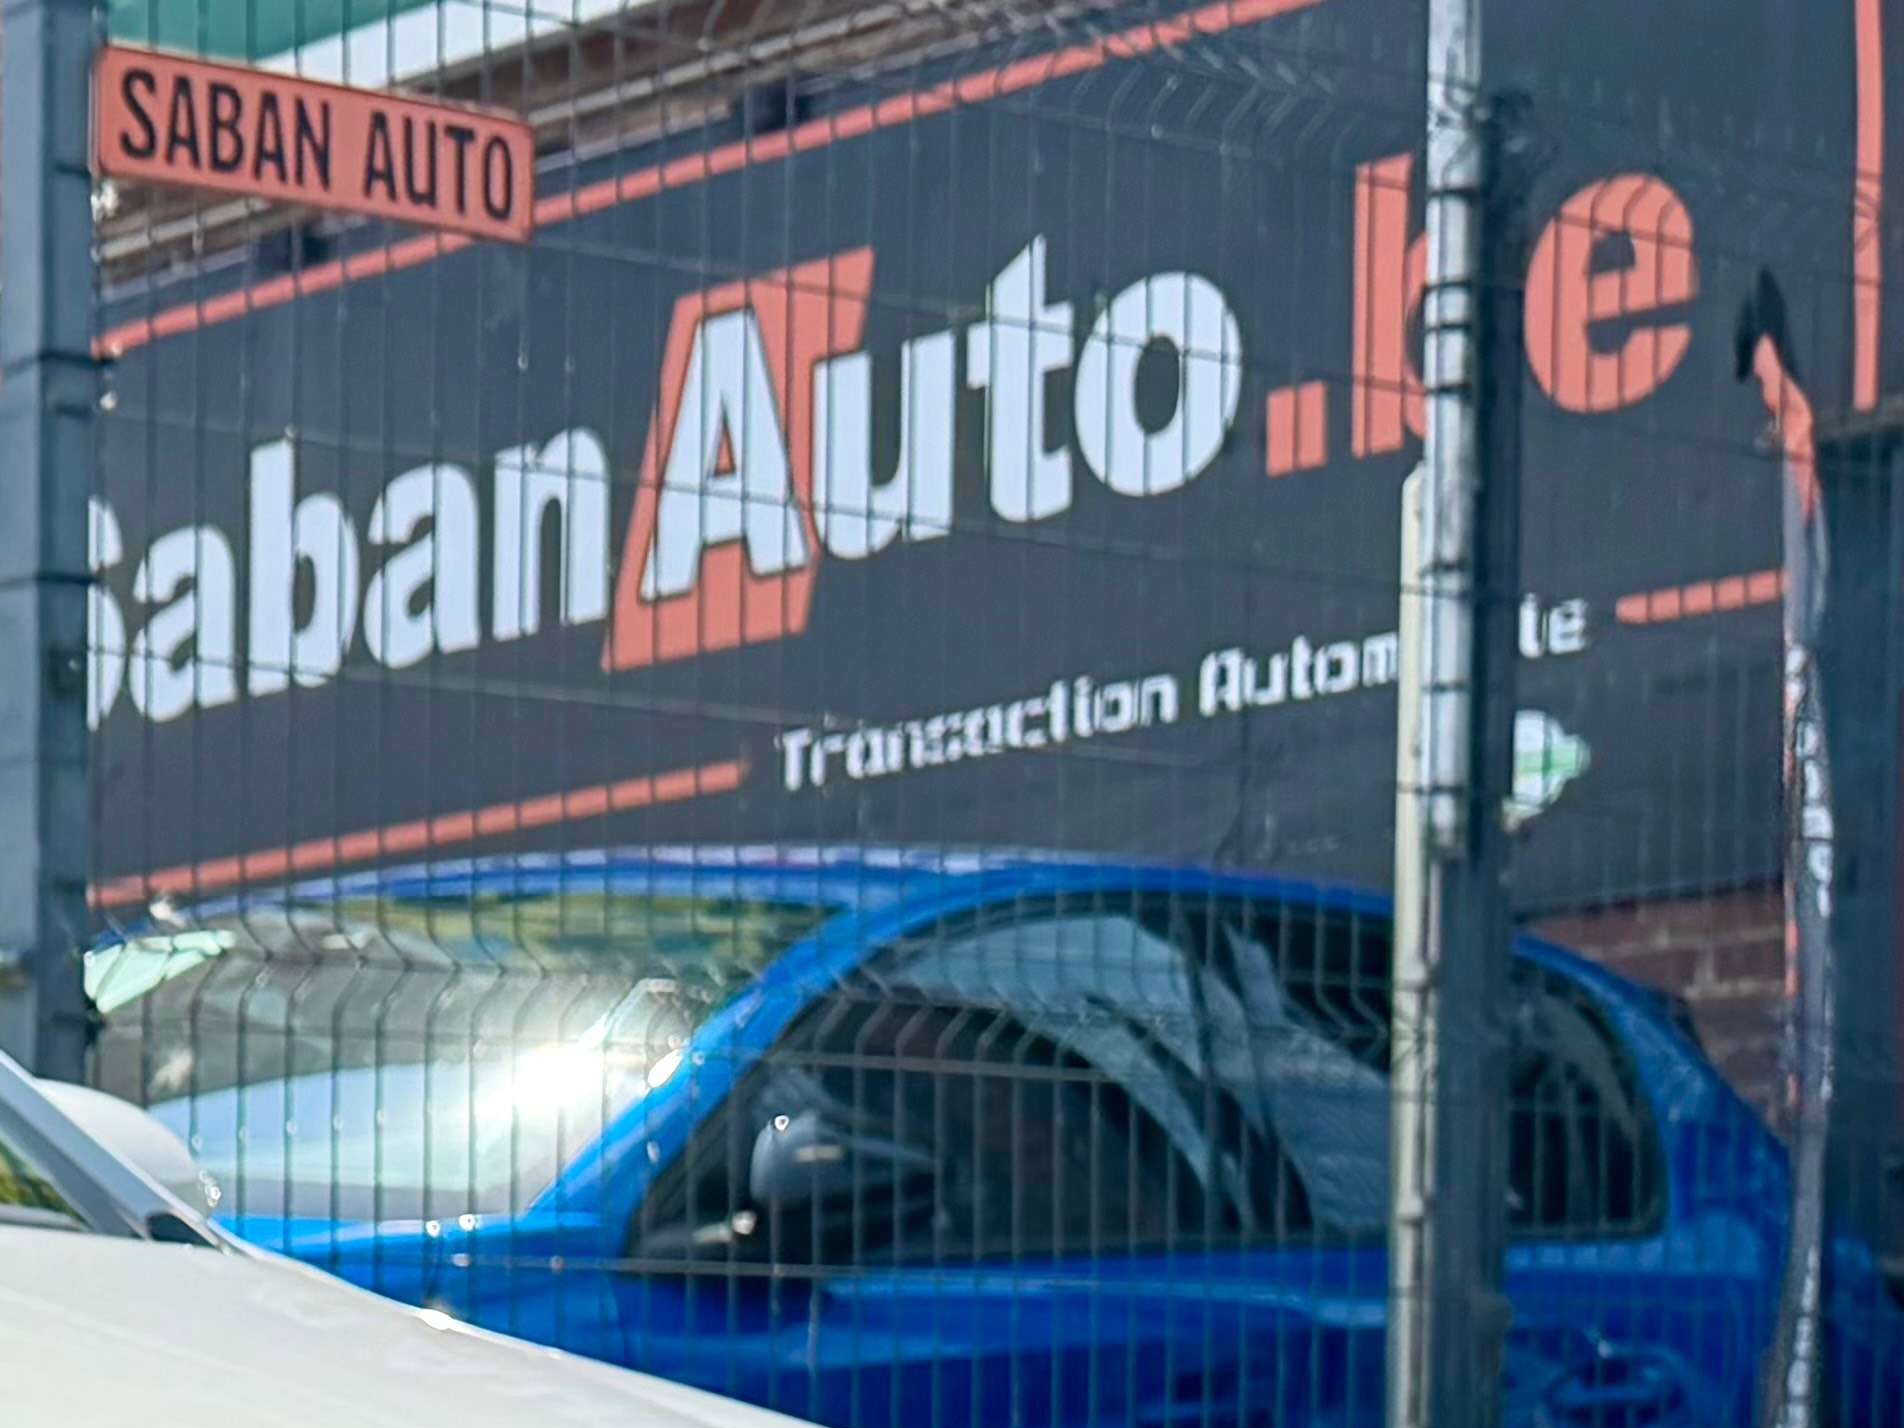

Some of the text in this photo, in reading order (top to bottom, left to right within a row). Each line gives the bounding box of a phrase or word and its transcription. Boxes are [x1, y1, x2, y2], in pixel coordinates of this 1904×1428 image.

[121, 69, 514, 221] SABAN AUTO
[782, 592, 1586, 791] Transaction Automle
